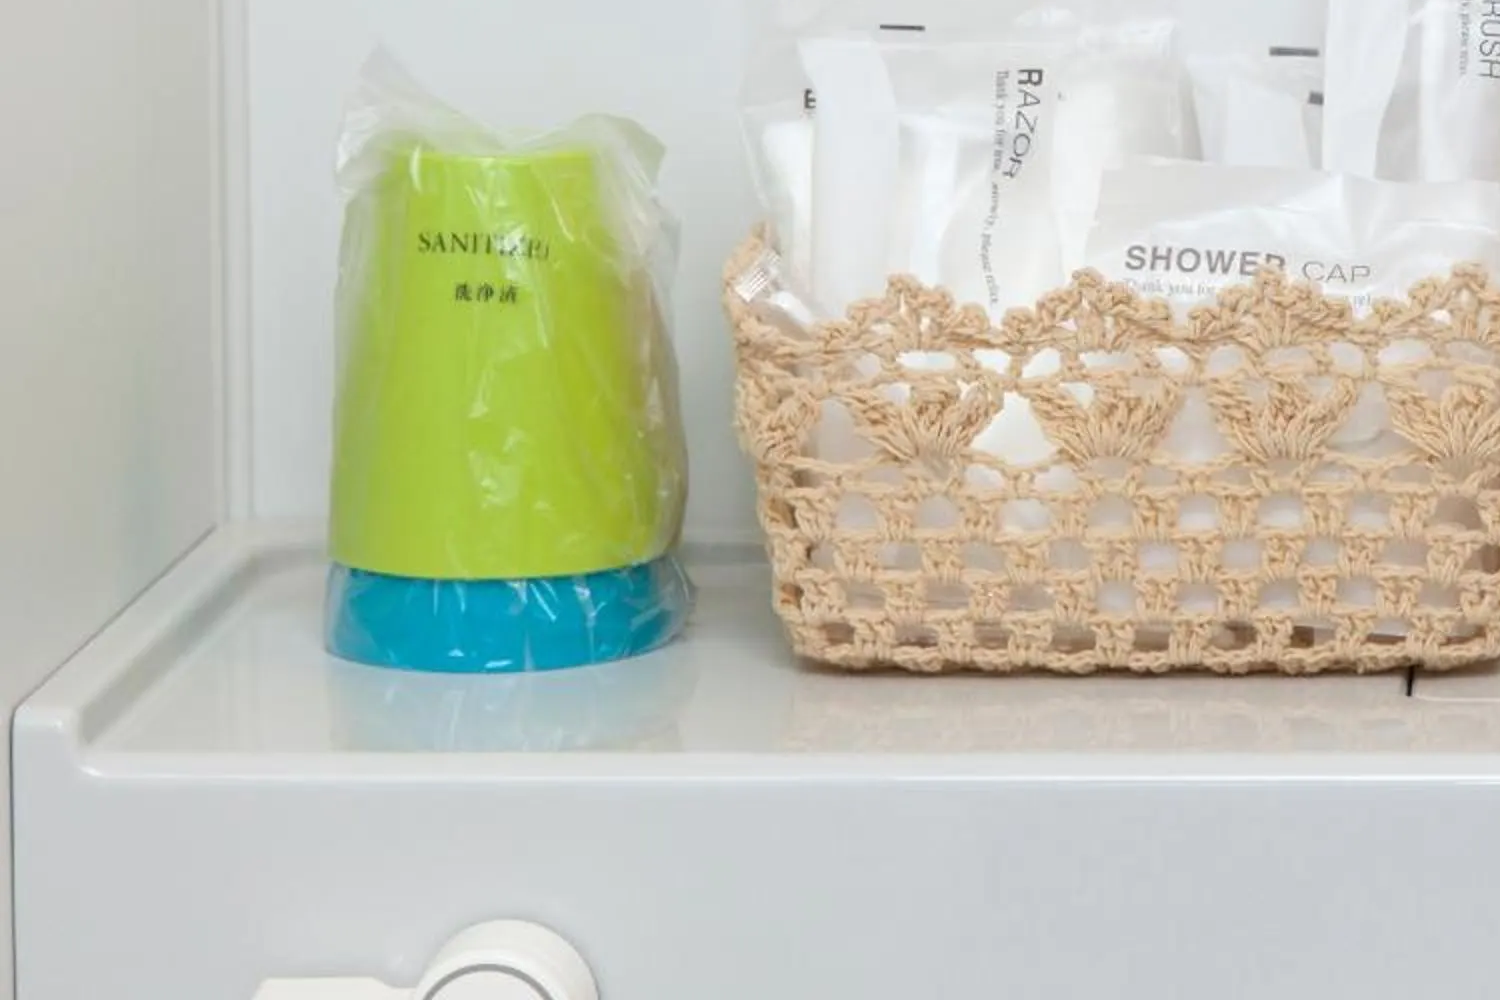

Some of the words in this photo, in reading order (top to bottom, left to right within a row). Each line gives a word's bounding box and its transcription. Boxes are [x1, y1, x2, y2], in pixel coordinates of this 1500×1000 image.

[1002, 68, 1043, 178] RAZOR
[1124, 244, 1286, 277] SHOWER
[1302, 261, 1371, 283] CAP
